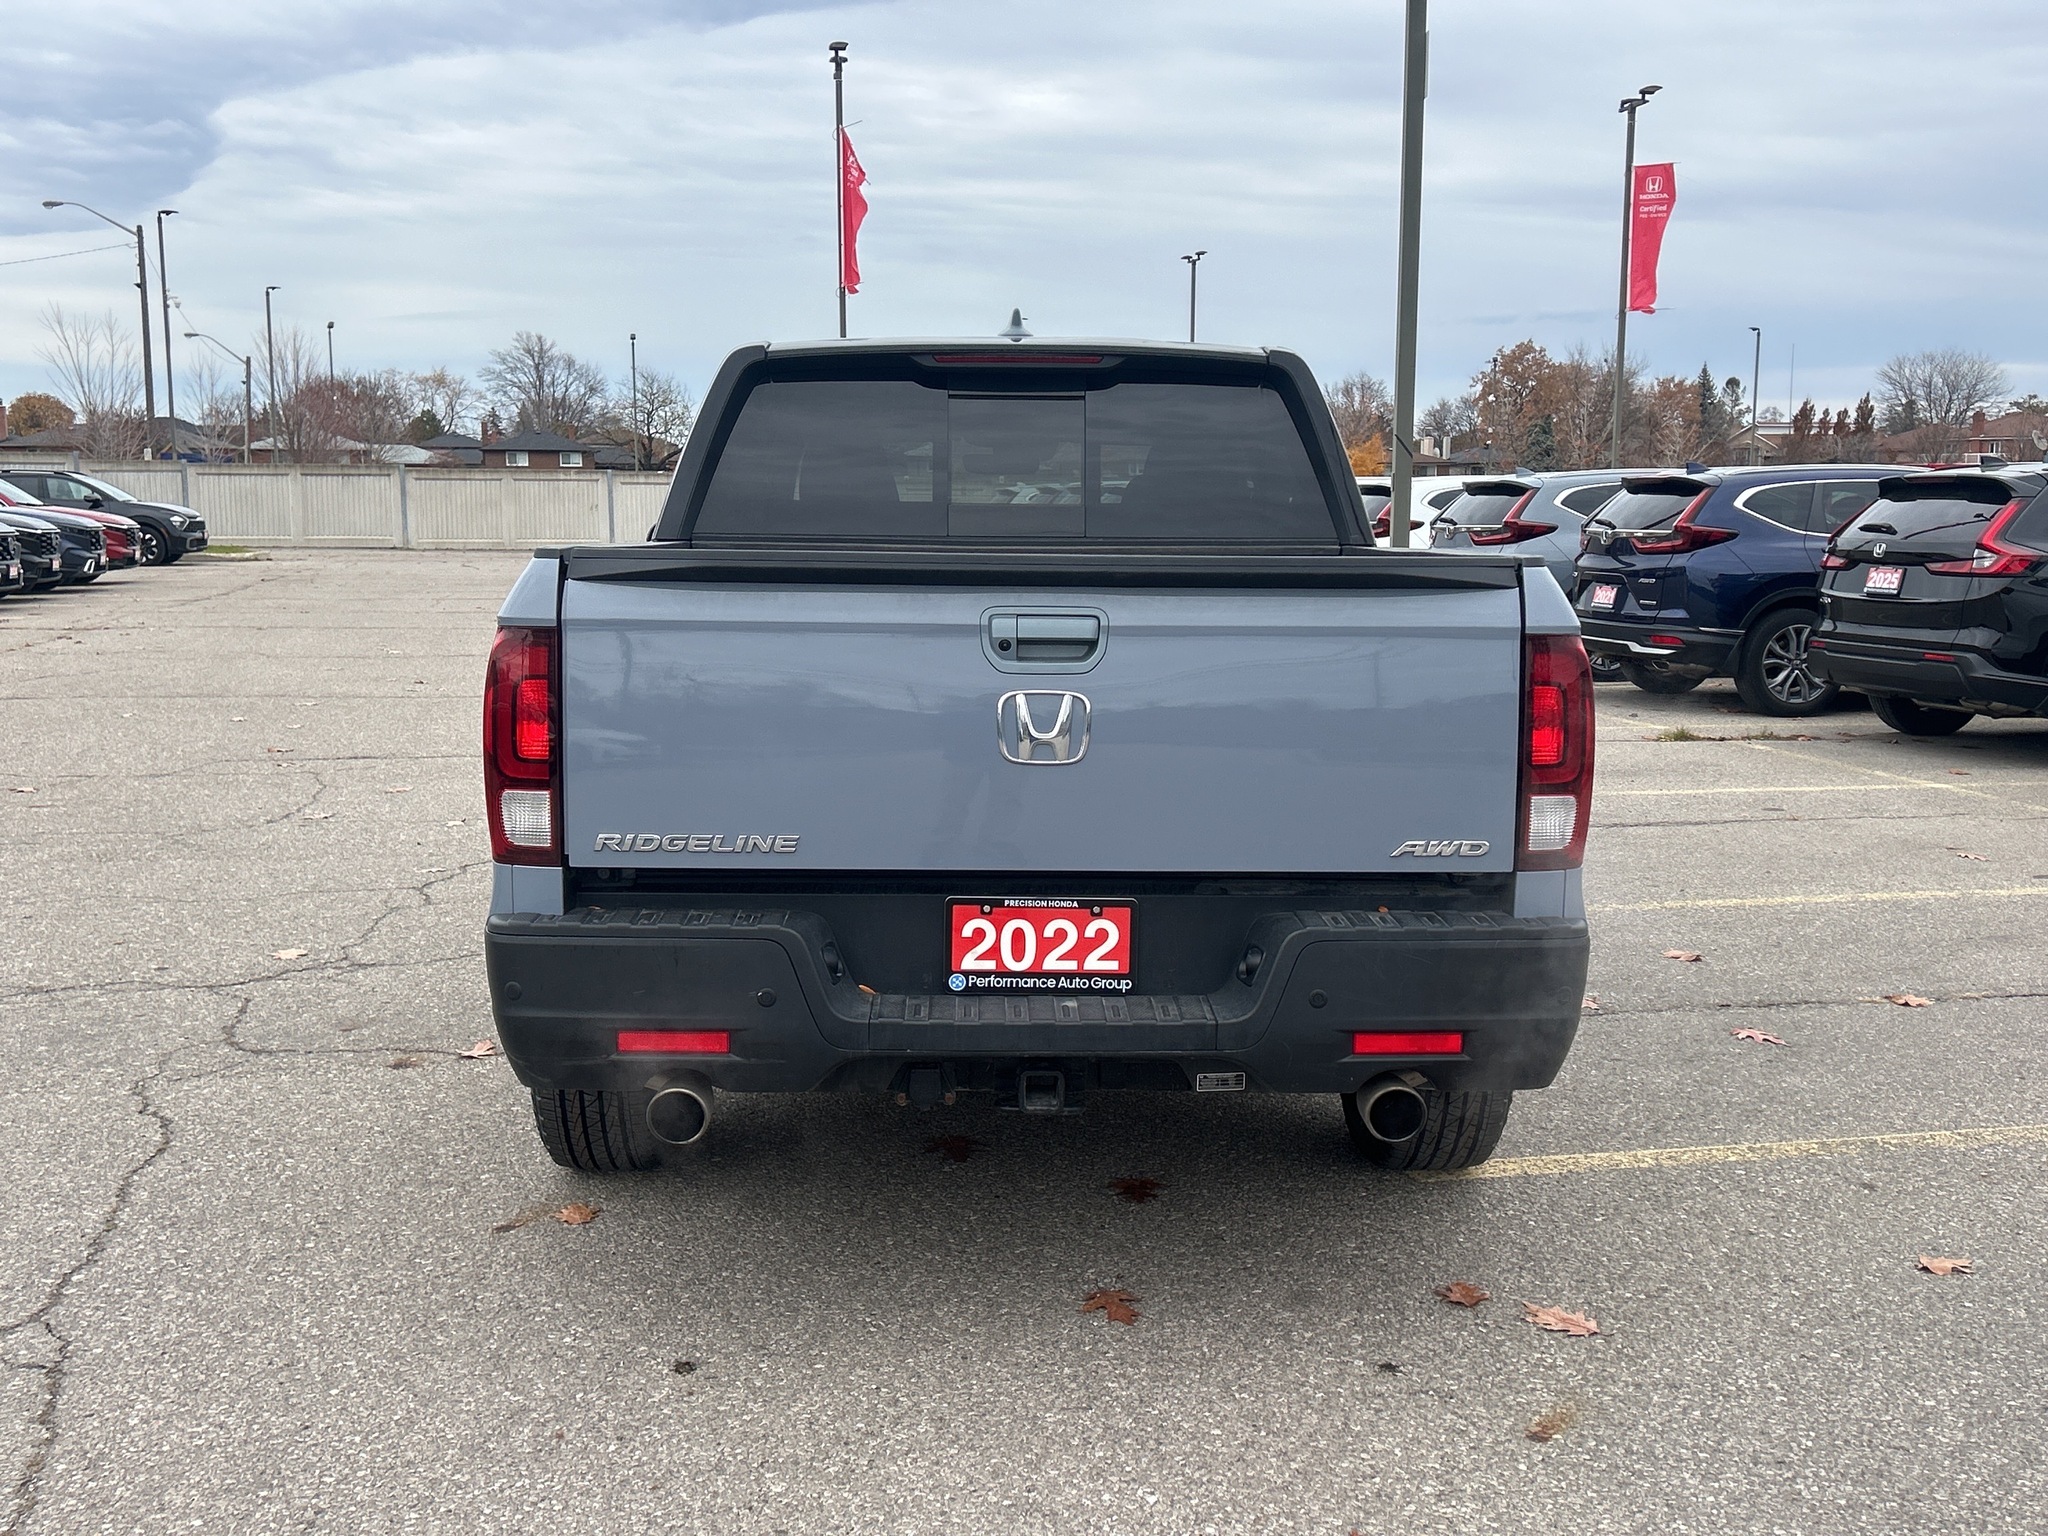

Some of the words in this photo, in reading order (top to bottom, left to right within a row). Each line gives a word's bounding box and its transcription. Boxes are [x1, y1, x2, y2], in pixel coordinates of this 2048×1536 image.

[1866, 572, 1899, 588] 2025
[594, 833, 800, 853] RIDGELINE
[1390, 840, 1490, 858] AWD
[1004, 899, 1047, 907] PRECISION
[1048, 900, 1079, 908] HONDA
[960, 917, 1120, 972] 2022
[968, 975, 1056, 988] Performance
[1058, 976, 1089, 990] Auto
[1090, 977, 1132, 992] Group
